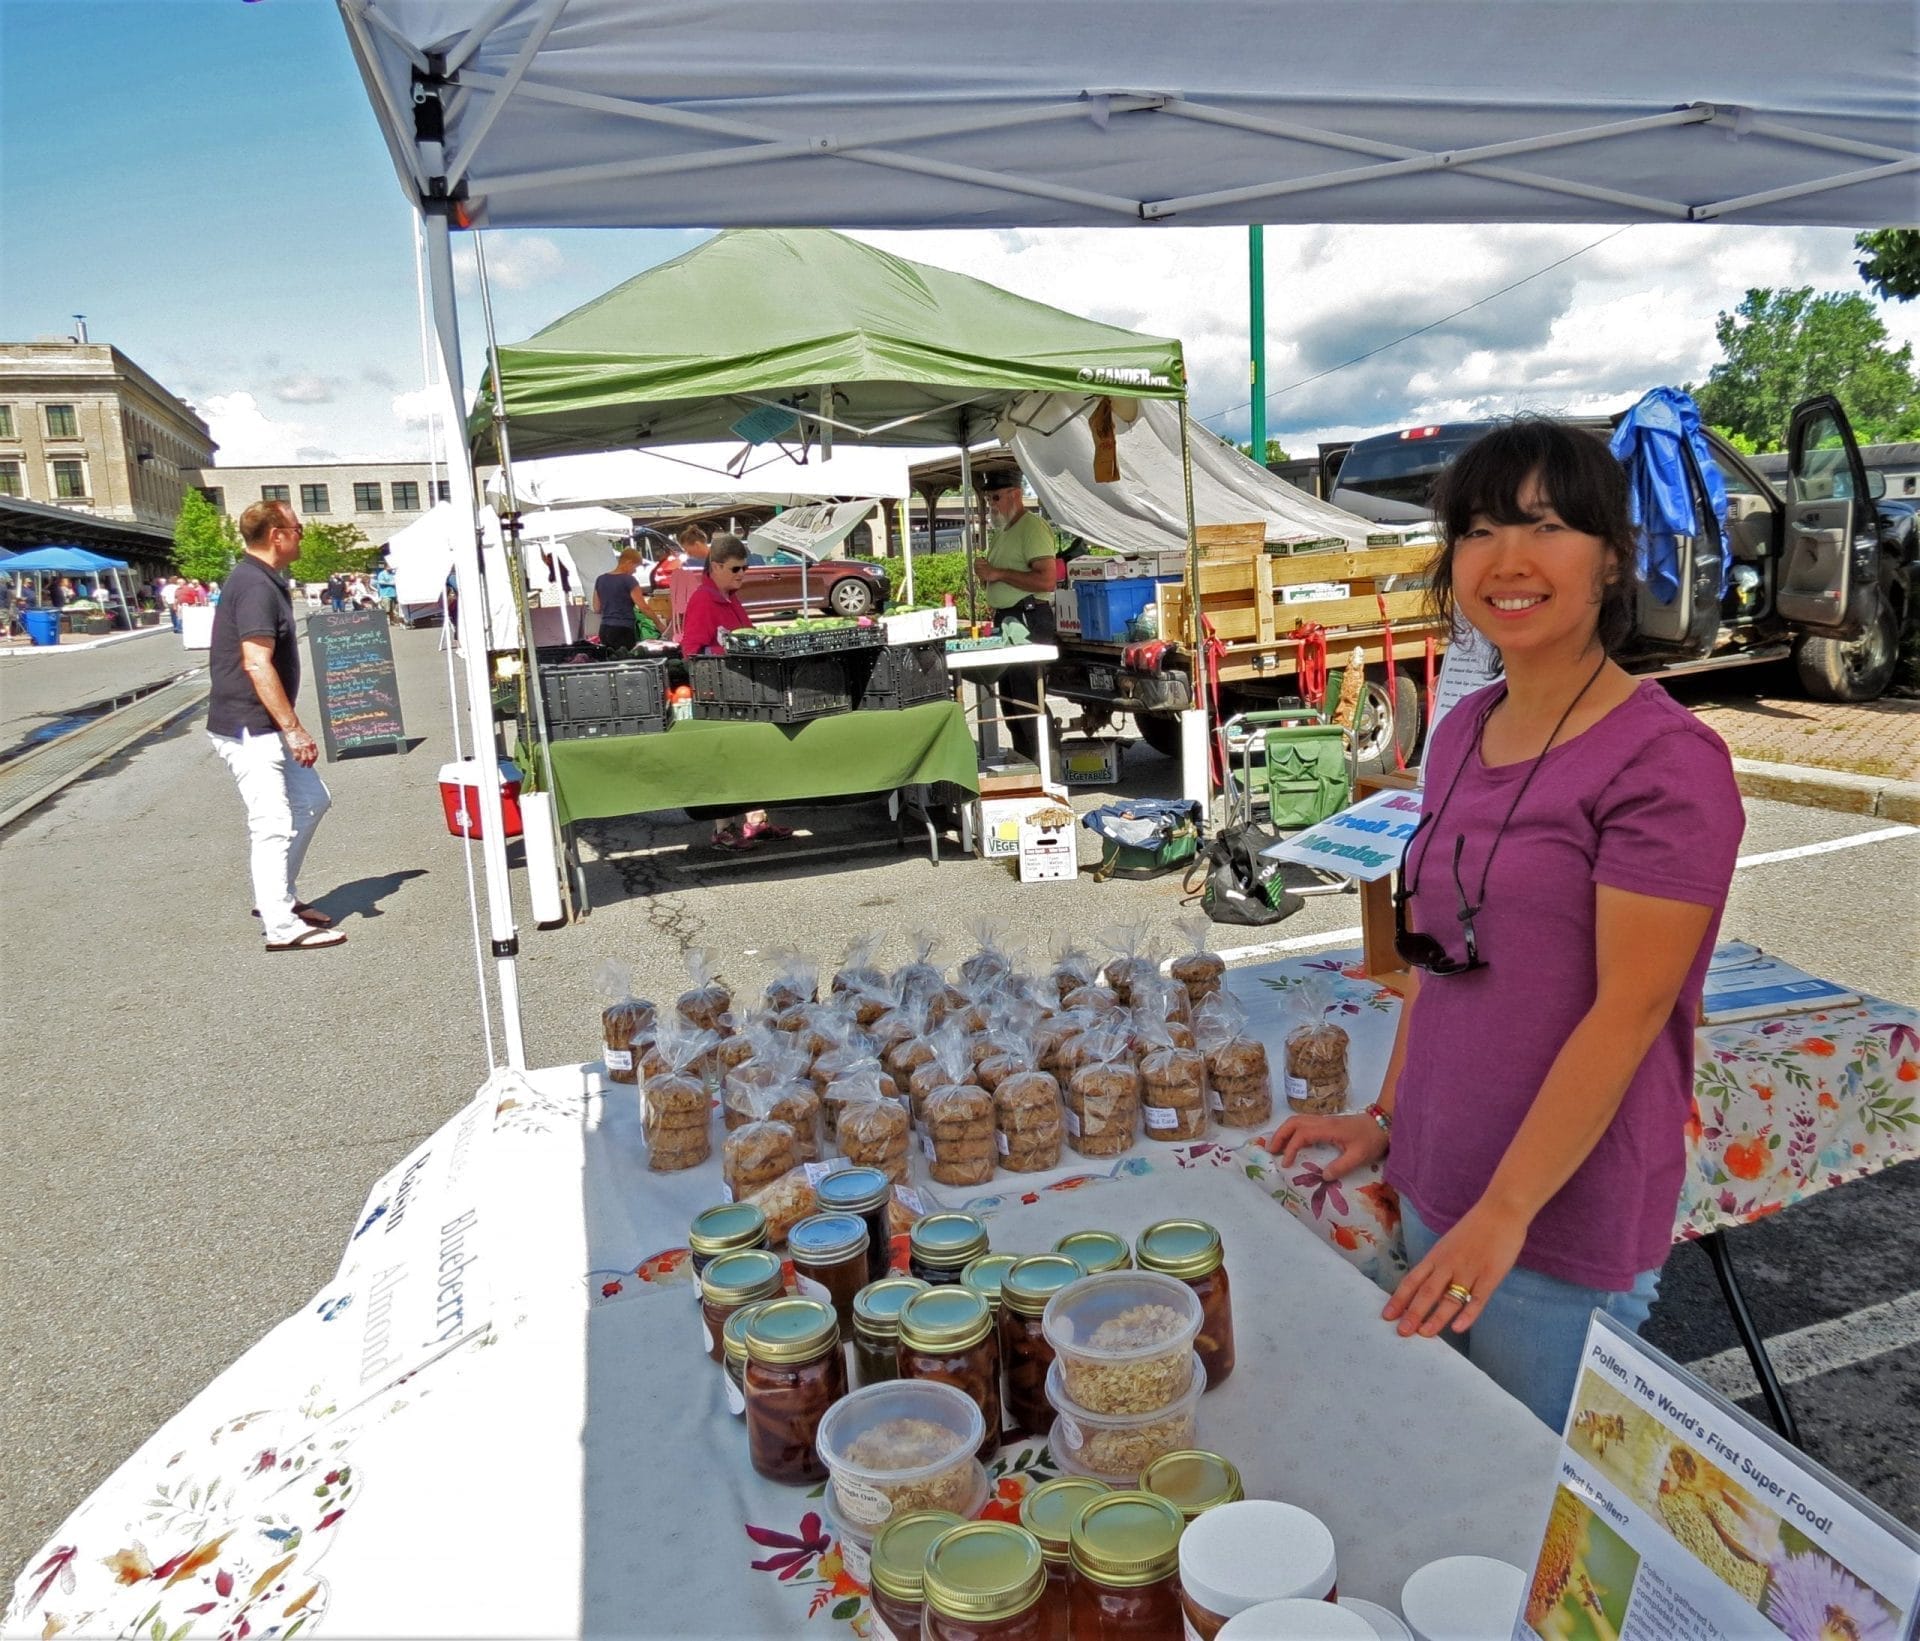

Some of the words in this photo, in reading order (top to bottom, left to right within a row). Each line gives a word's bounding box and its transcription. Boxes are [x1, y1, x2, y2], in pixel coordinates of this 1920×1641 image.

[1094, 367, 1150, 387] GANDER
[1292, 833, 1396, 868] Morning
[384, 1150, 432, 1235] Raisin
[422, 1206, 479, 1348] Blueberry
[359, 1261, 410, 1387] Almond
[1591, 1345, 1629, 1384] Pollen,
[1633, 1375, 1655, 1401] The
[1657, 1393, 1705, 1439] World's
[1706, 1432, 1740, 1466] First
[1741, 1457, 1786, 1498] Super
[1786, 1492, 1834, 1535] Food!
[1562, 1462, 1586, 1488] What
[1594, 1491, 1630, 1526] Pollen?
[1636, 1586, 1678, 1630] completely
[1639, 1573, 1652, 1590] the
[1652, 1586, 1674, 1613] young
[1642, 1561, 1665, 1587] Pollen
[1665, 1582, 1673, 1595] is
[1673, 1592, 1708, 1627] gathered
[1707, 1620, 1719, 1637] by
[1642, 1606, 1673, 1640] nutrients
